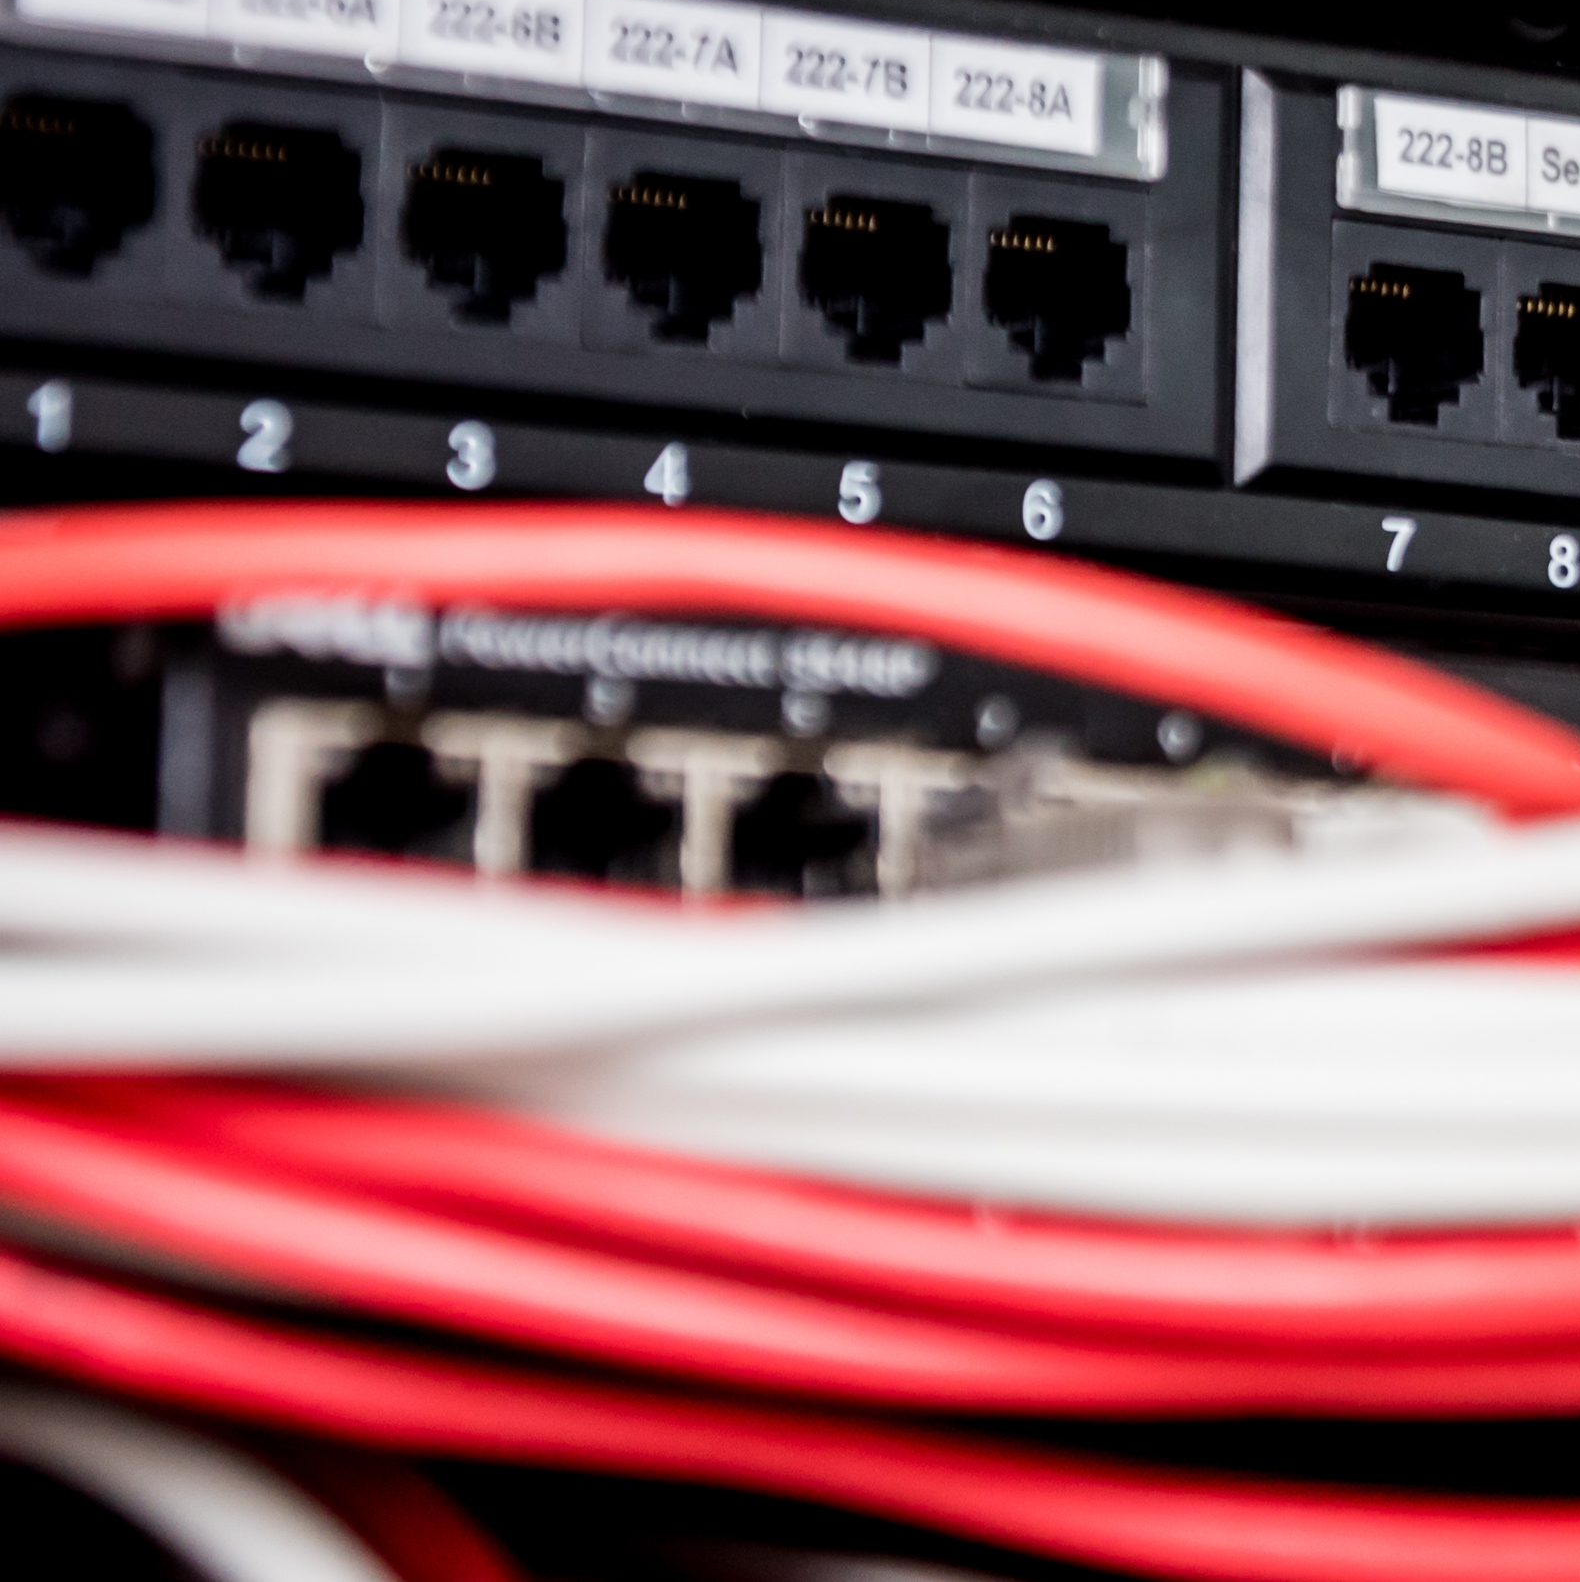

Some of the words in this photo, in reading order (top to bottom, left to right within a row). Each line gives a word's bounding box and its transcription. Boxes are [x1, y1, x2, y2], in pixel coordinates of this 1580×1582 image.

[609, 19, 740, 76] 222-7A
[785, 42, 909, 98] 222-7B
[954, 66, 1074, 119] 222-8A
[1398, 129, 1509, 177] 222-8B
[26, 381, 73, 448] 1
[236, 400, 293, 472] 2
[445, 421, 496, 490] 3
[643, 444, 688, 506] 4
[837, 461, 881, 525] 5
[1022, 479, 1064, 541] 6
[1381, 516, 1417, 572] 7
[1547, 534, 1580, 589] 8
